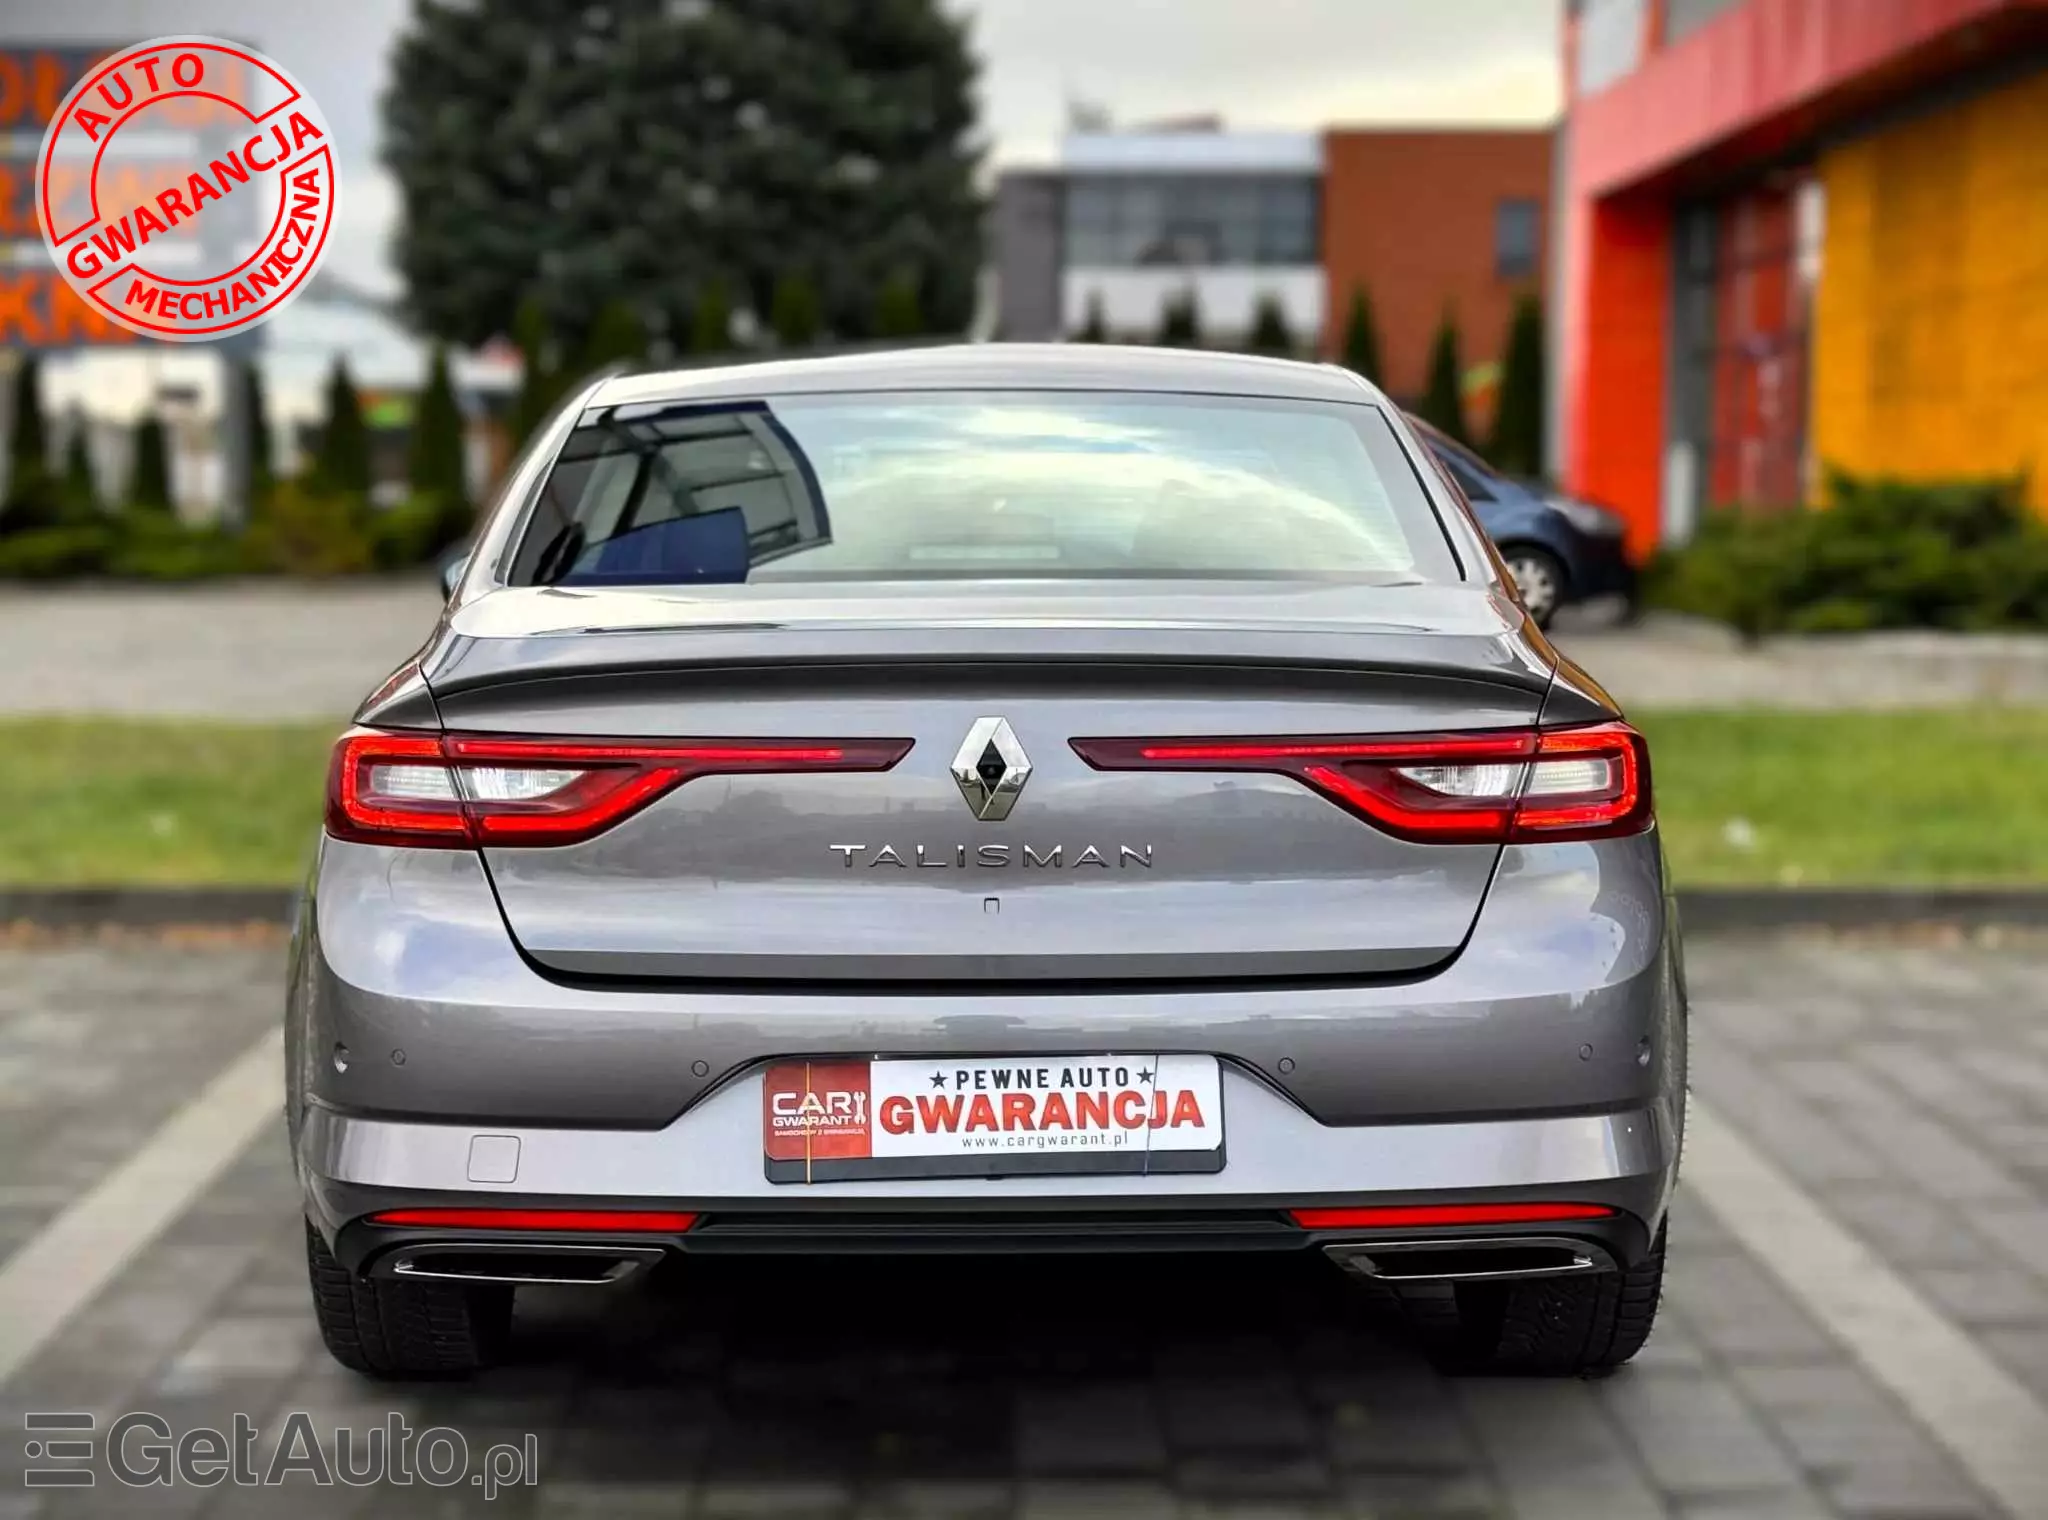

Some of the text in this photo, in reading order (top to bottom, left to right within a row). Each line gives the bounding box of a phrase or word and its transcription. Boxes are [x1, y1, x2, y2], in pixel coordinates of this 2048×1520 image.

[829, 844, 1153, 868] TALISMAN
[956, 1067, 1129, 1090] PEWNE AUTO
[772, 1091, 853, 1116] CAR
[879, 1089, 1206, 1135] GWARANCJA
[772, 1115, 853, 1127] GWARANT
[962, 1131, 1128, 1149] www.cargwarant.pl
